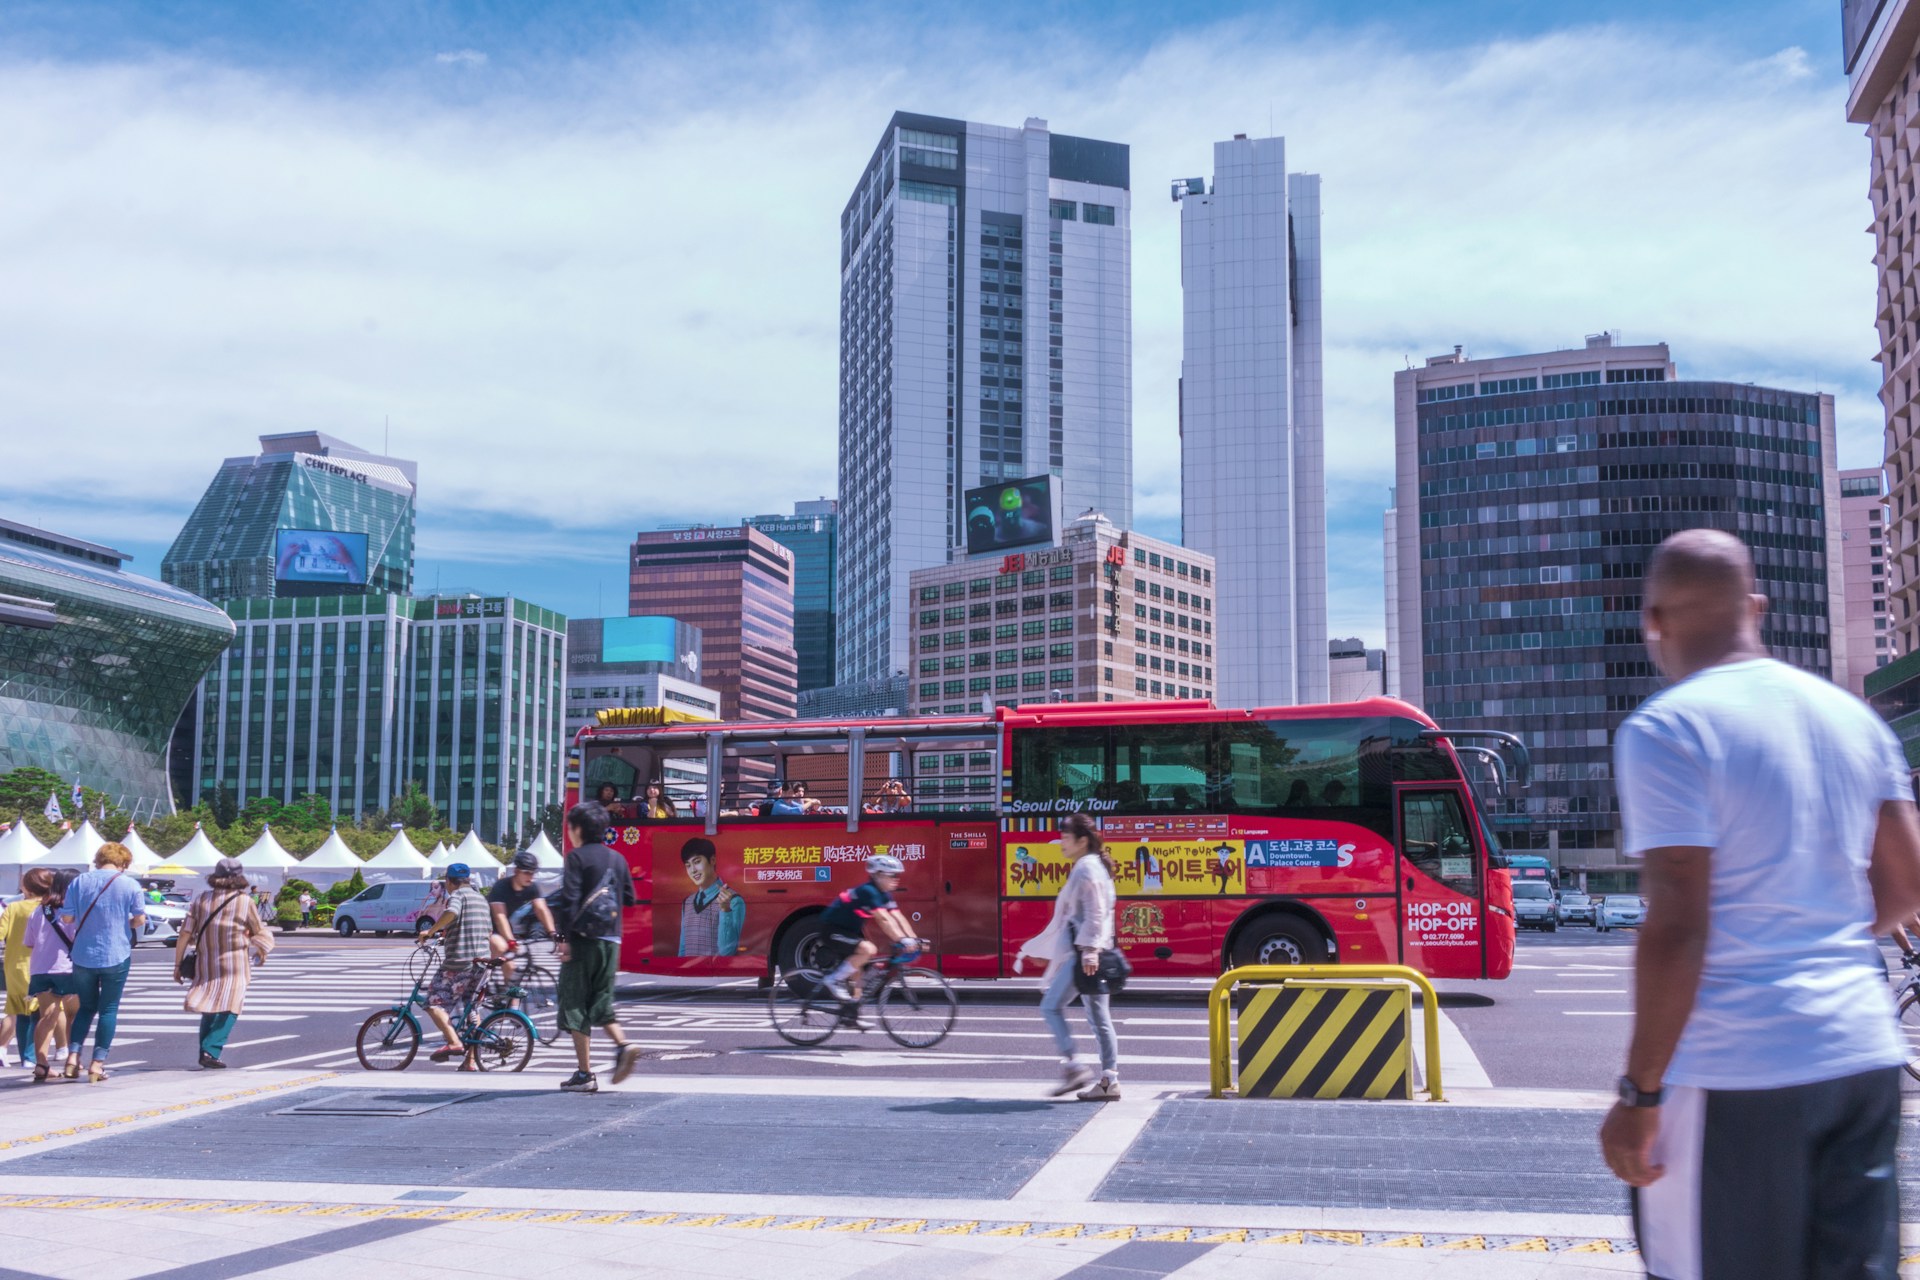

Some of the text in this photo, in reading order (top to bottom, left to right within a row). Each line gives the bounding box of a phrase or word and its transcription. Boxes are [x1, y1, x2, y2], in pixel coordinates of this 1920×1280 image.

[305, 457, 369, 484] CENTERPLACE
[706, 529, 741, 539] 사랑으로
[759, 523, 775, 532] KEB
[776, 523, 796, 531] Hana
[999, 548, 1074, 574] JEI 재능교육
[1106, 545, 1126, 567] JEI
[465, 602, 503, 614] 금융그룹
[1012, 798, 1119, 815] Seoul City Tour
[1152, 845, 1213, 857] NIGHT TOUR
[1269, 840, 1336, 852] 도심.고궁 코스
[743, 846, 821, 865] 新罗免税店
[1247, 843, 1266, 865] A
[1270, 859, 1320, 868] Palace Course
[757, 869, 803, 881] 新罗免税店
[1010, 861, 1074, 884] SUMM
[1407, 902, 1472, 916] HOP-ON
[1408, 917, 1478, 931] HOP-OFF
[1409, 940, 1479, 948] www.seoulcitybus.com
